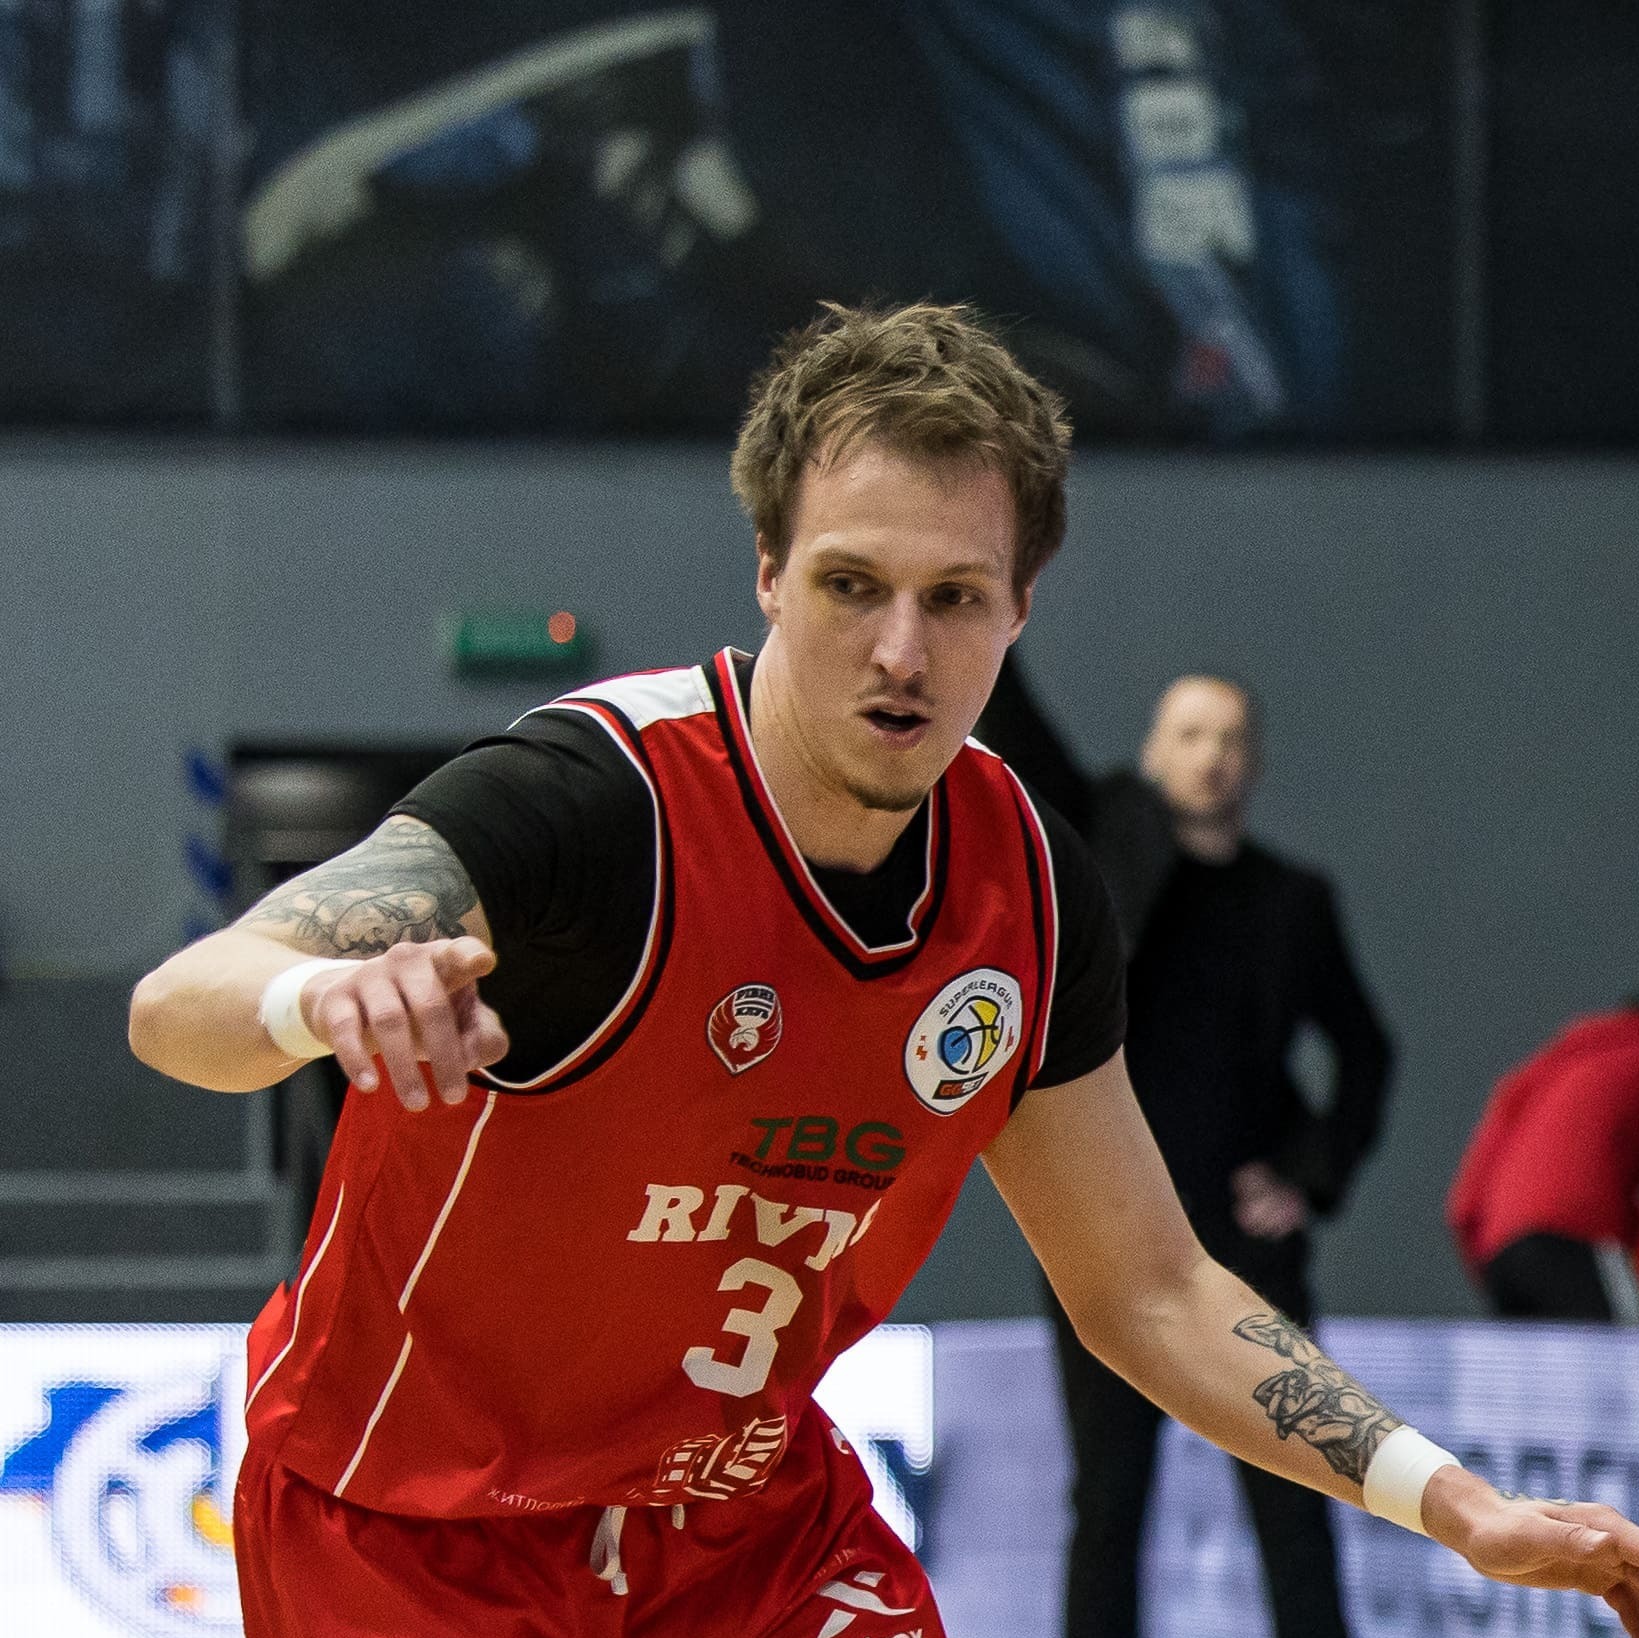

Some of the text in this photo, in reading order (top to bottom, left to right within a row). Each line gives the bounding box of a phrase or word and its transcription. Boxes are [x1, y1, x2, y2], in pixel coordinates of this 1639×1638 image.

[729, 1152, 828, 1181] TECHNOBUD
[752, 1116, 906, 1171] TBG
[681, 1256, 803, 1398] 3
